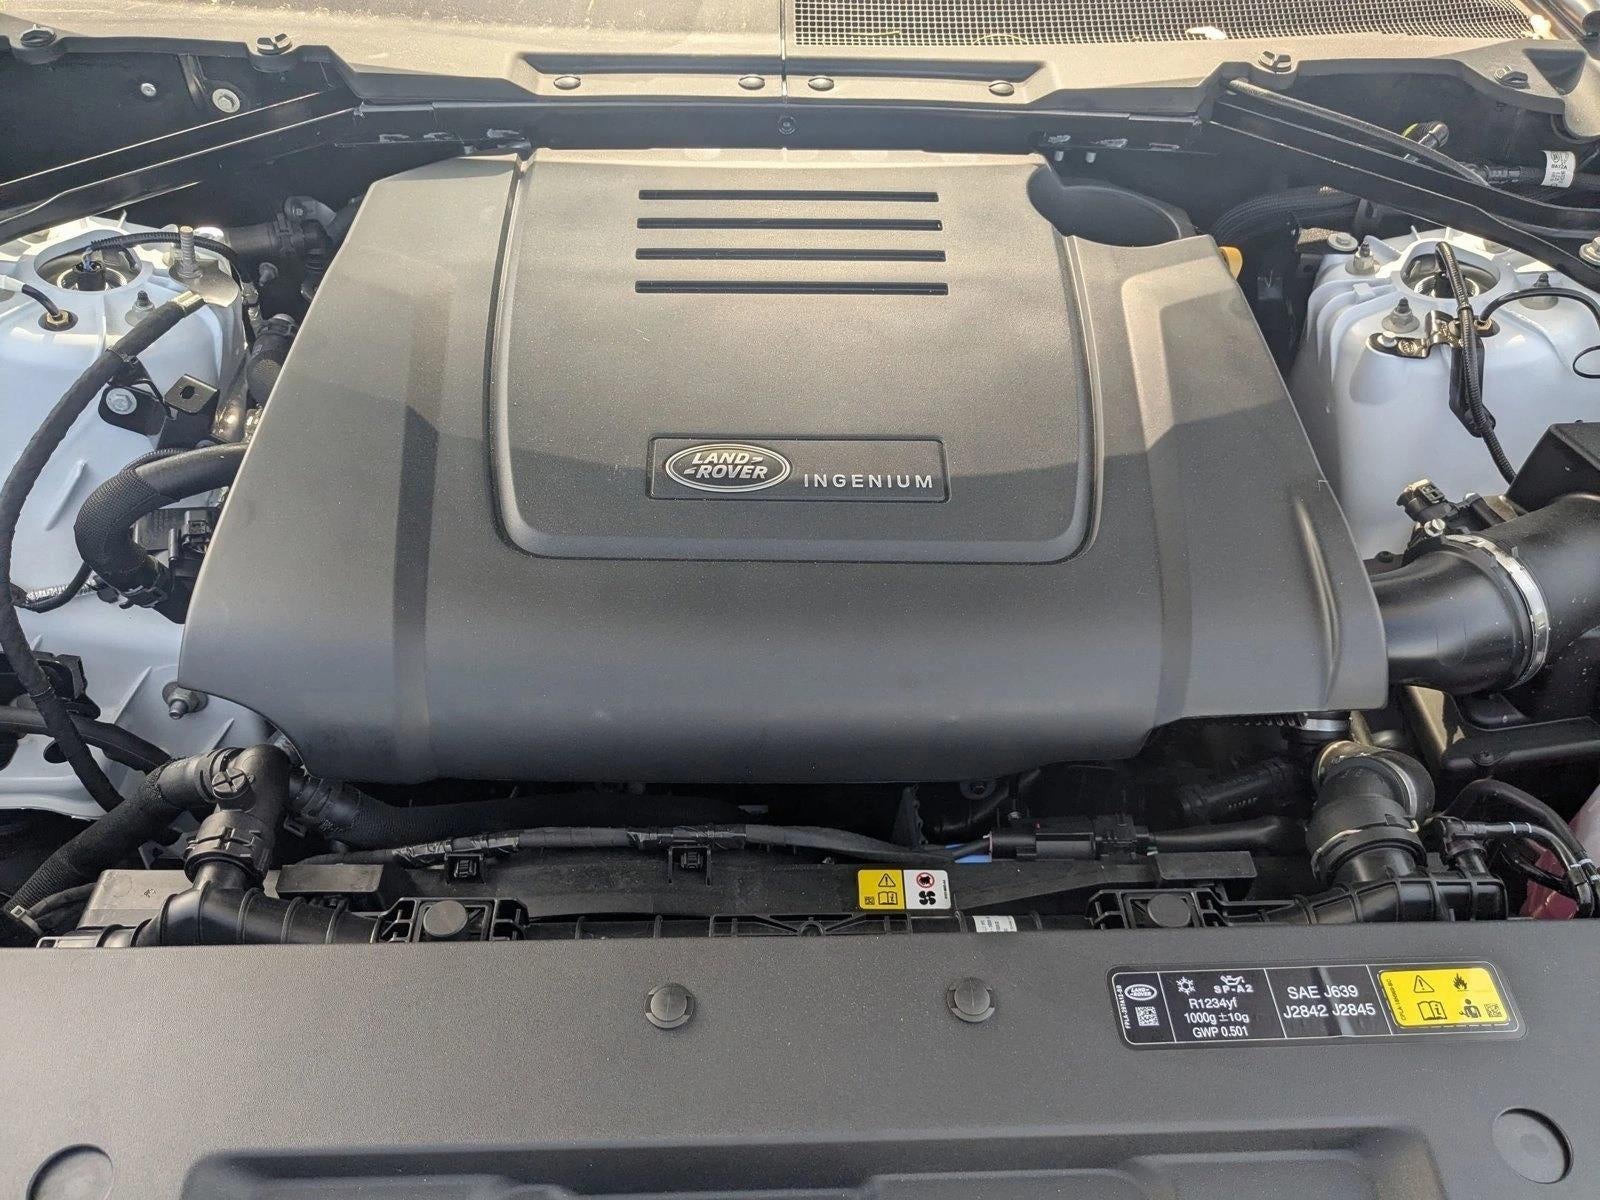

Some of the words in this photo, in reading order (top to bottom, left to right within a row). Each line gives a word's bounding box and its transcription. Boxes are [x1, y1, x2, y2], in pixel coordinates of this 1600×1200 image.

[692, 452, 749, 464] LAND
[696, 465, 768, 479] ROVER
[803, 473, 933, 488] INGENIUM
[1213, 984, 1254, 994] SP-A2
[1287, 985, 1321, 999] SAE
[1324, 984, 1358, 998] J639
[1188, 997, 1238, 1011] R1234yf
[1283, 1004, 1329, 1019] J2842
[1332, 1002, 1376, 1016] J2845
[1183, 1012, 1217, 1025] 1000g
[1192, 1027, 1219, 1038] GWP
[1221, 1026, 1249, 1037] 0.501
